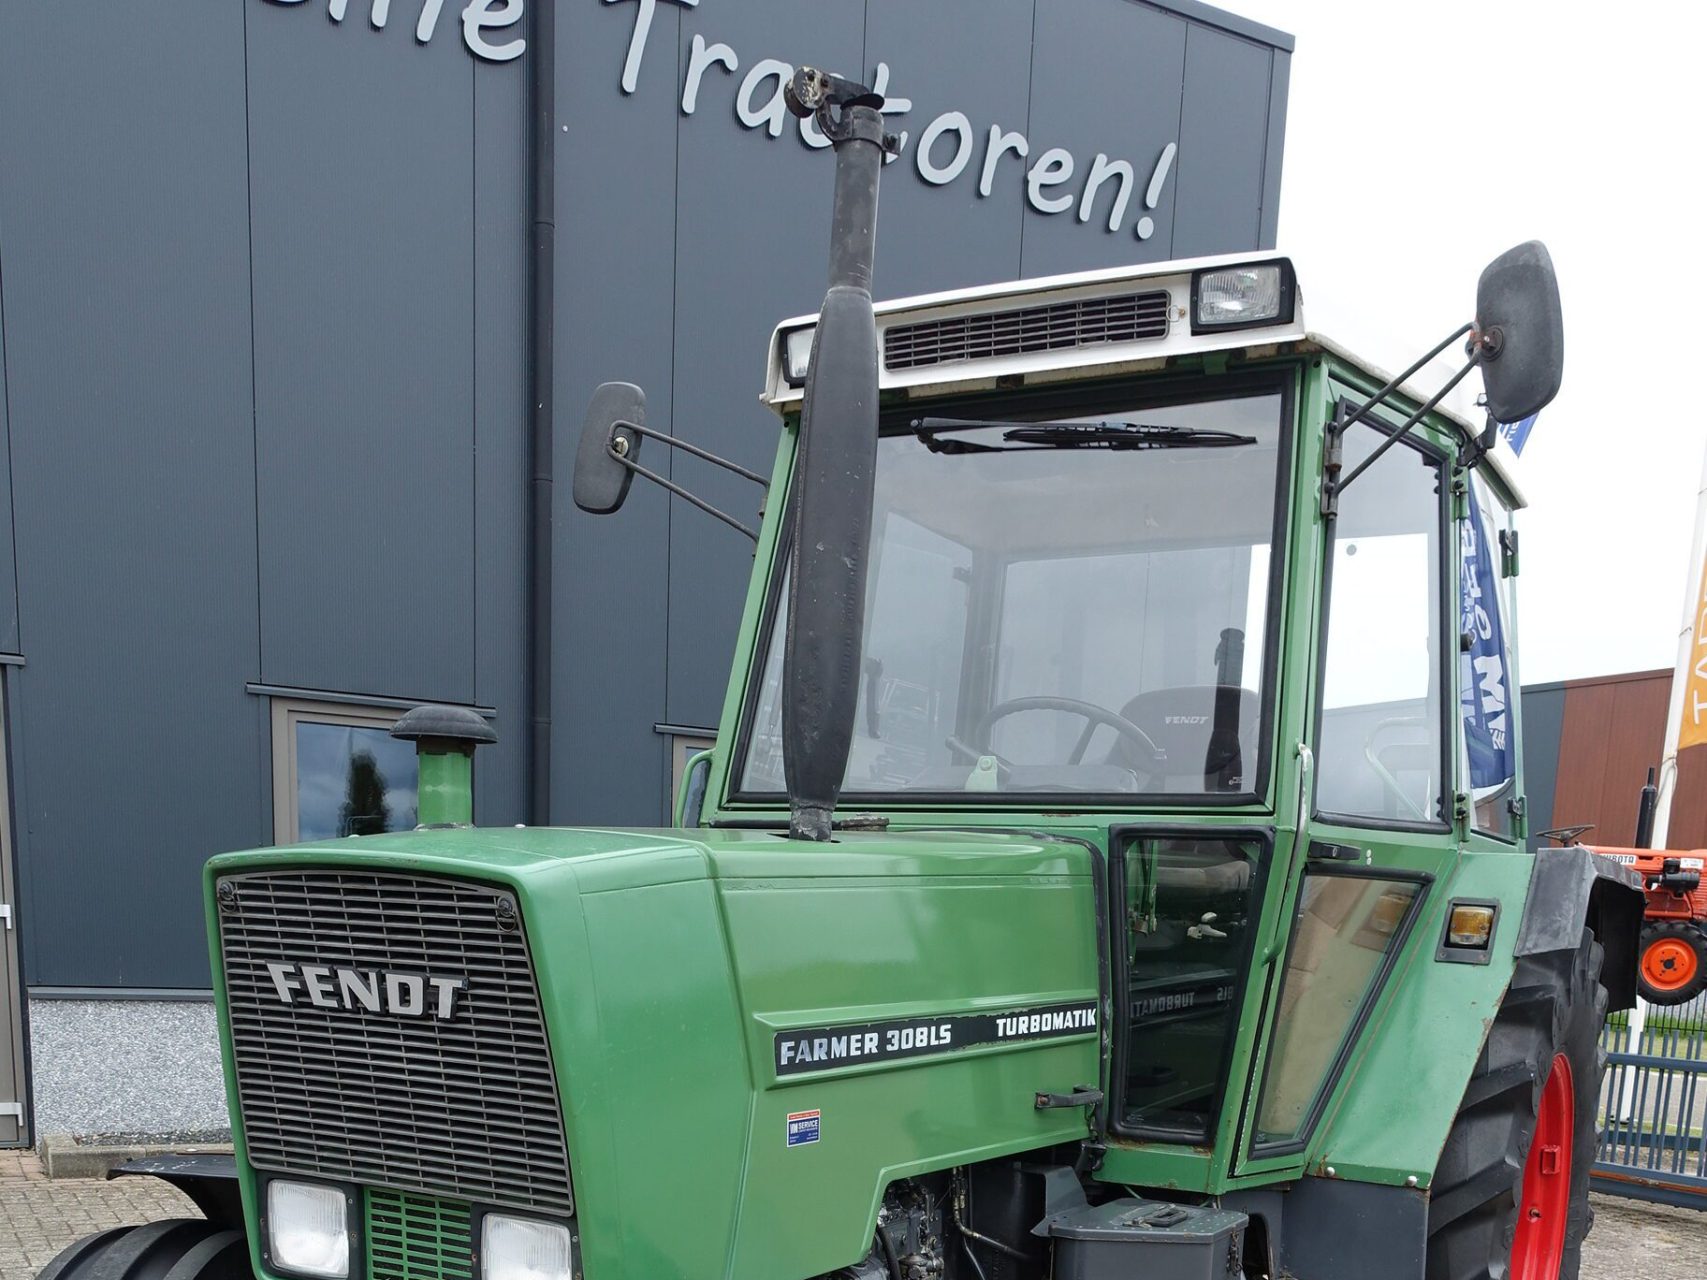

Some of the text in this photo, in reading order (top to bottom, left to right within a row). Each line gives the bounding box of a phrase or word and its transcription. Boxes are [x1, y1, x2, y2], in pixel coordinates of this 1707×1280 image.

[266, 961, 468, 1020] FENDT
[780, 1008, 1097, 1066] FARMER 308LS TURBOMATIK
[798, 1119, 819, 1130] SERVICE
